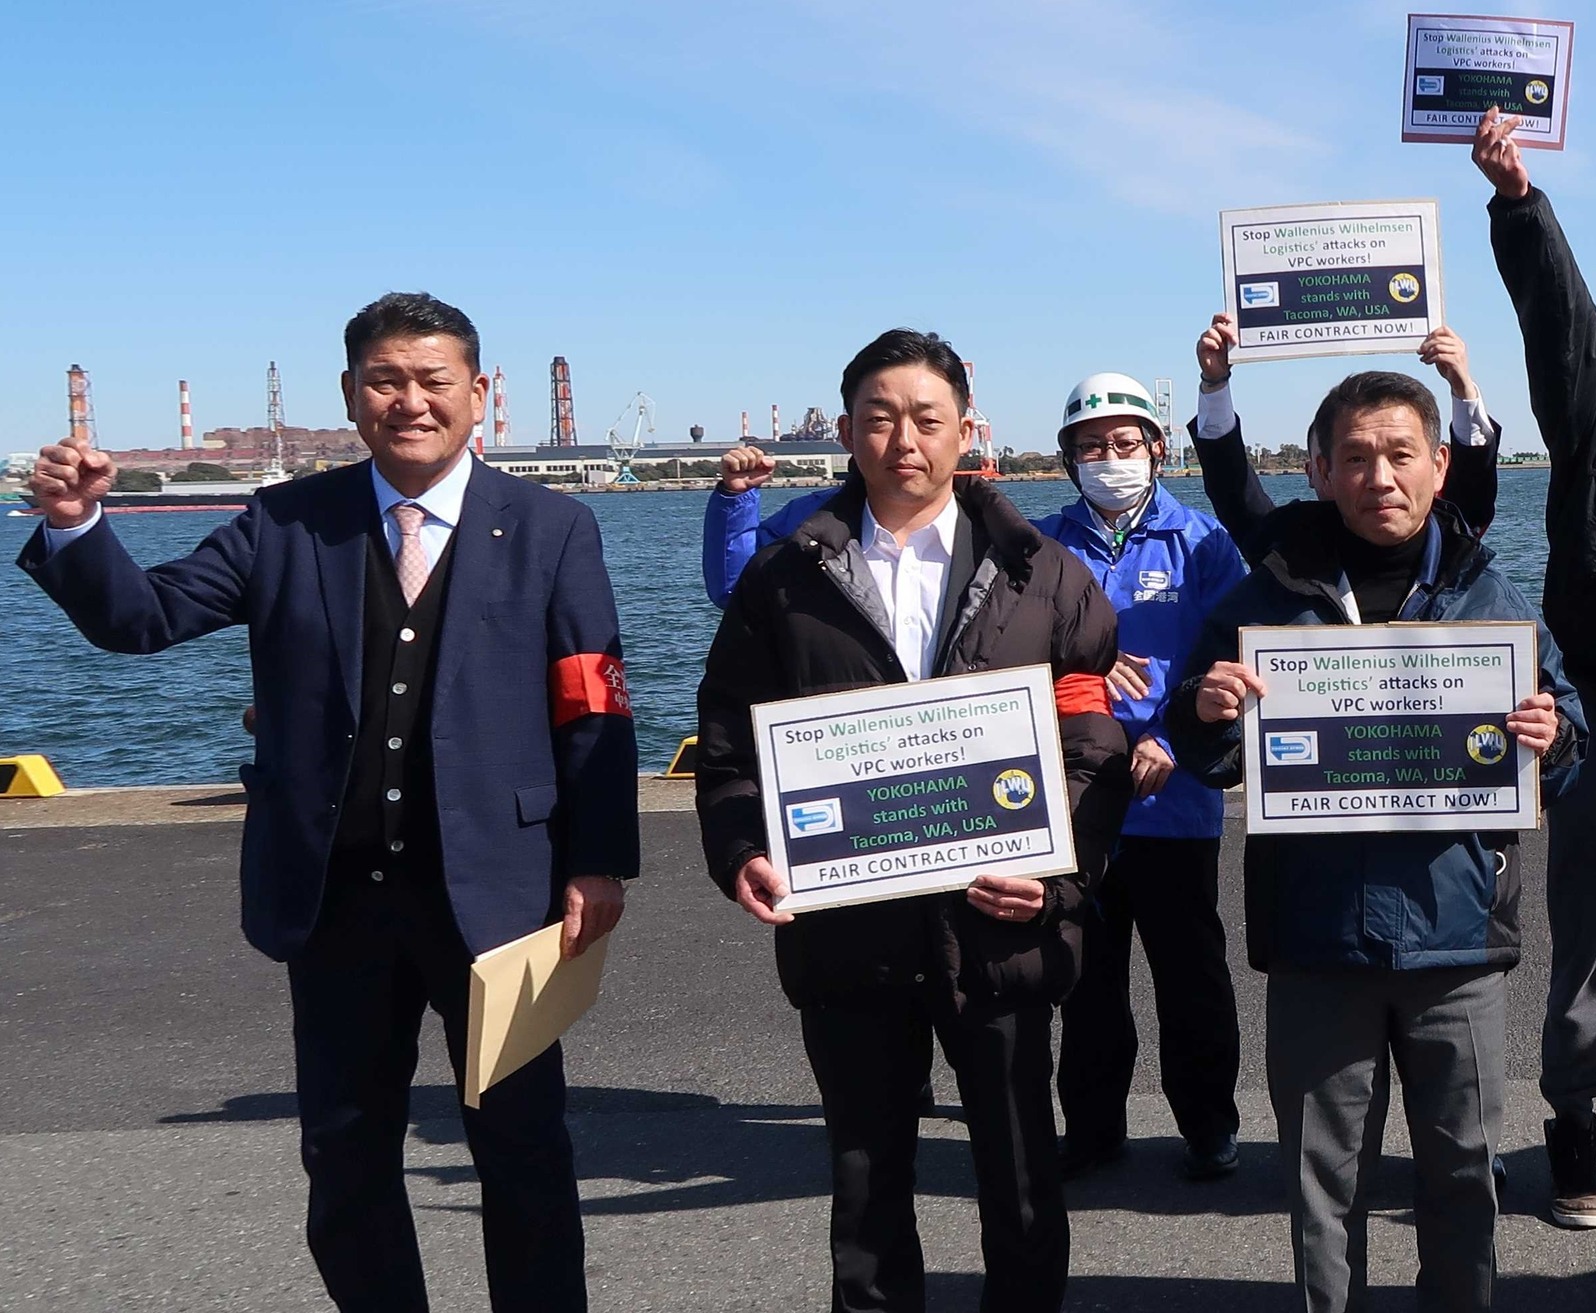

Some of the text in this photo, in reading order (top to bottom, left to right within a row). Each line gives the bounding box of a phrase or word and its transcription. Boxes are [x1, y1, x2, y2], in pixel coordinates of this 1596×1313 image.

[1242, 223, 1413, 242] Stop Wallenius Wilhelmsen
[1322, 239, 1367, 251] attacks
[1287, 253, 1371, 268] VPC workers!
[1298, 274, 1371, 287] YOKOHAMA
[1301, 289, 1371, 304] stands with
[1283, 304, 1390, 320] Tacoma, WA, USA
[1260, 322, 1414, 341] FAIR CONTRACT NOW!
[1269, 652, 1501, 674] Stop Wallenius Wilhelmsen
[1378, 674, 1438, 689] attacks
[1442, 677, 1464, 688] on
[1330, 695, 1443, 712] VPC workers!
[784, 700, 1019, 743] Stop Wallenius Wilhelmsen
[897, 727, 957, 748] attacks
[961, 726, 984, 738] on
[1343, 724, 1442, 739] YOKOHAMA
[849, 745, 965, 775] VPC workers!
[1347, 744, 1441, 761] stands with
[1322, 766, 1466, 785] Tacoma, WA, USA
[866, 774, 967, 800] YOKOHAMA
[872, 796, 968, 822] stands with
[1290, 792, 1498, 811] FAIR CONTRACT NOW!
[848, 814, 996, 848] Tacoma, WA, USA
[818, 835, 1031, 880] FAIR CONTRACT NOW!
